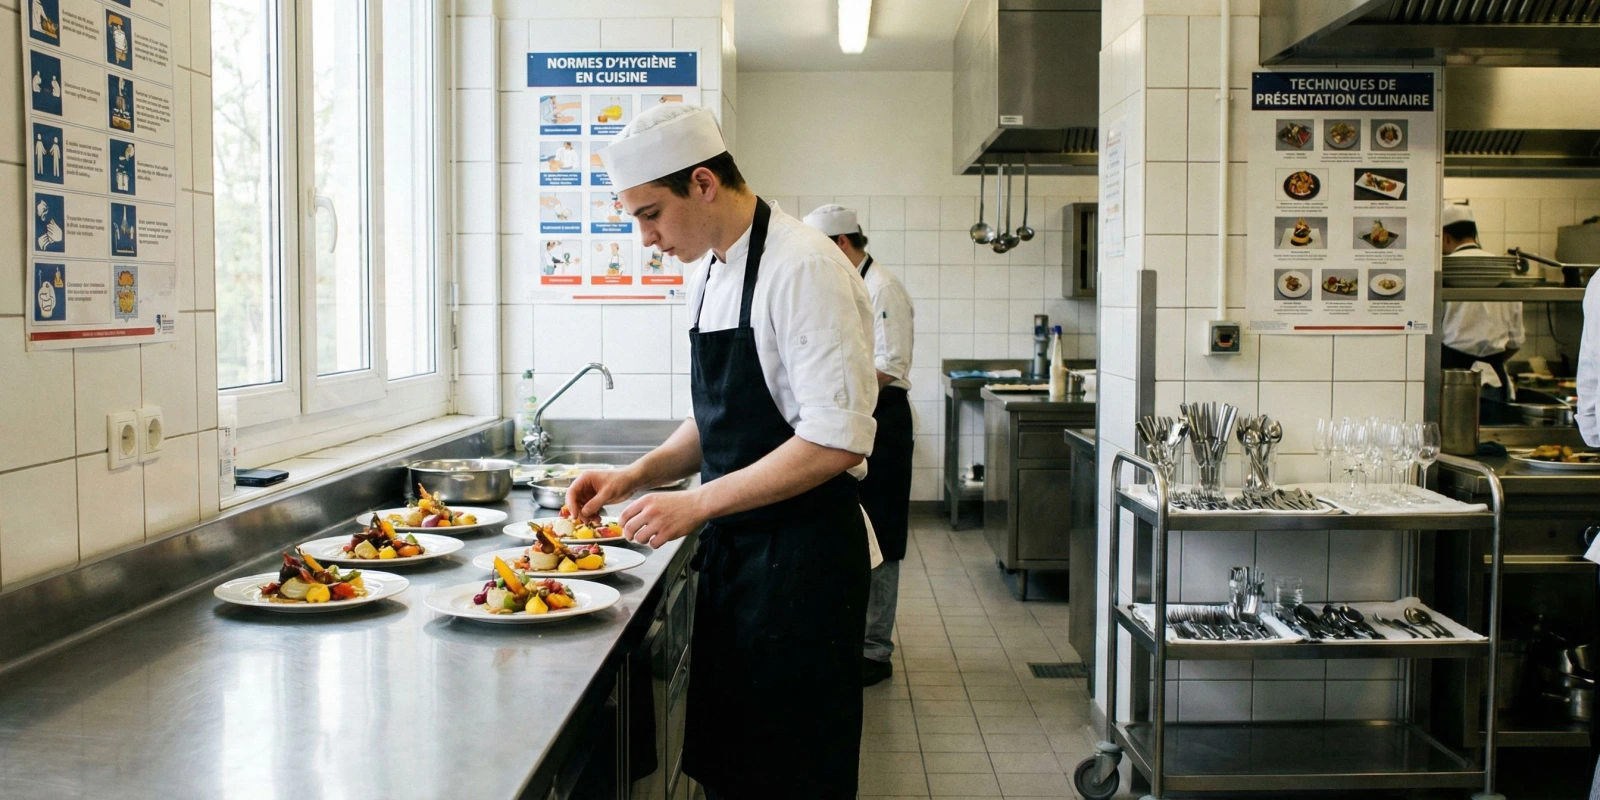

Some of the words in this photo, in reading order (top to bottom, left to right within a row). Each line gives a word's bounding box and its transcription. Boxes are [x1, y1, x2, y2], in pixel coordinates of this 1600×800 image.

[547, 57, 603, 69] NORMES
[576, 72, 593, 83] EN
[596, 72, 648, 84] CUISINE
[1290, 78, 1375, 91] TECHNIQUES
[1379, 78, 1396, 90] DE
[1256, 91, 1355, 105] PRÉSENTATION
[1359, 93, 1429, 106] CULINAIRE
